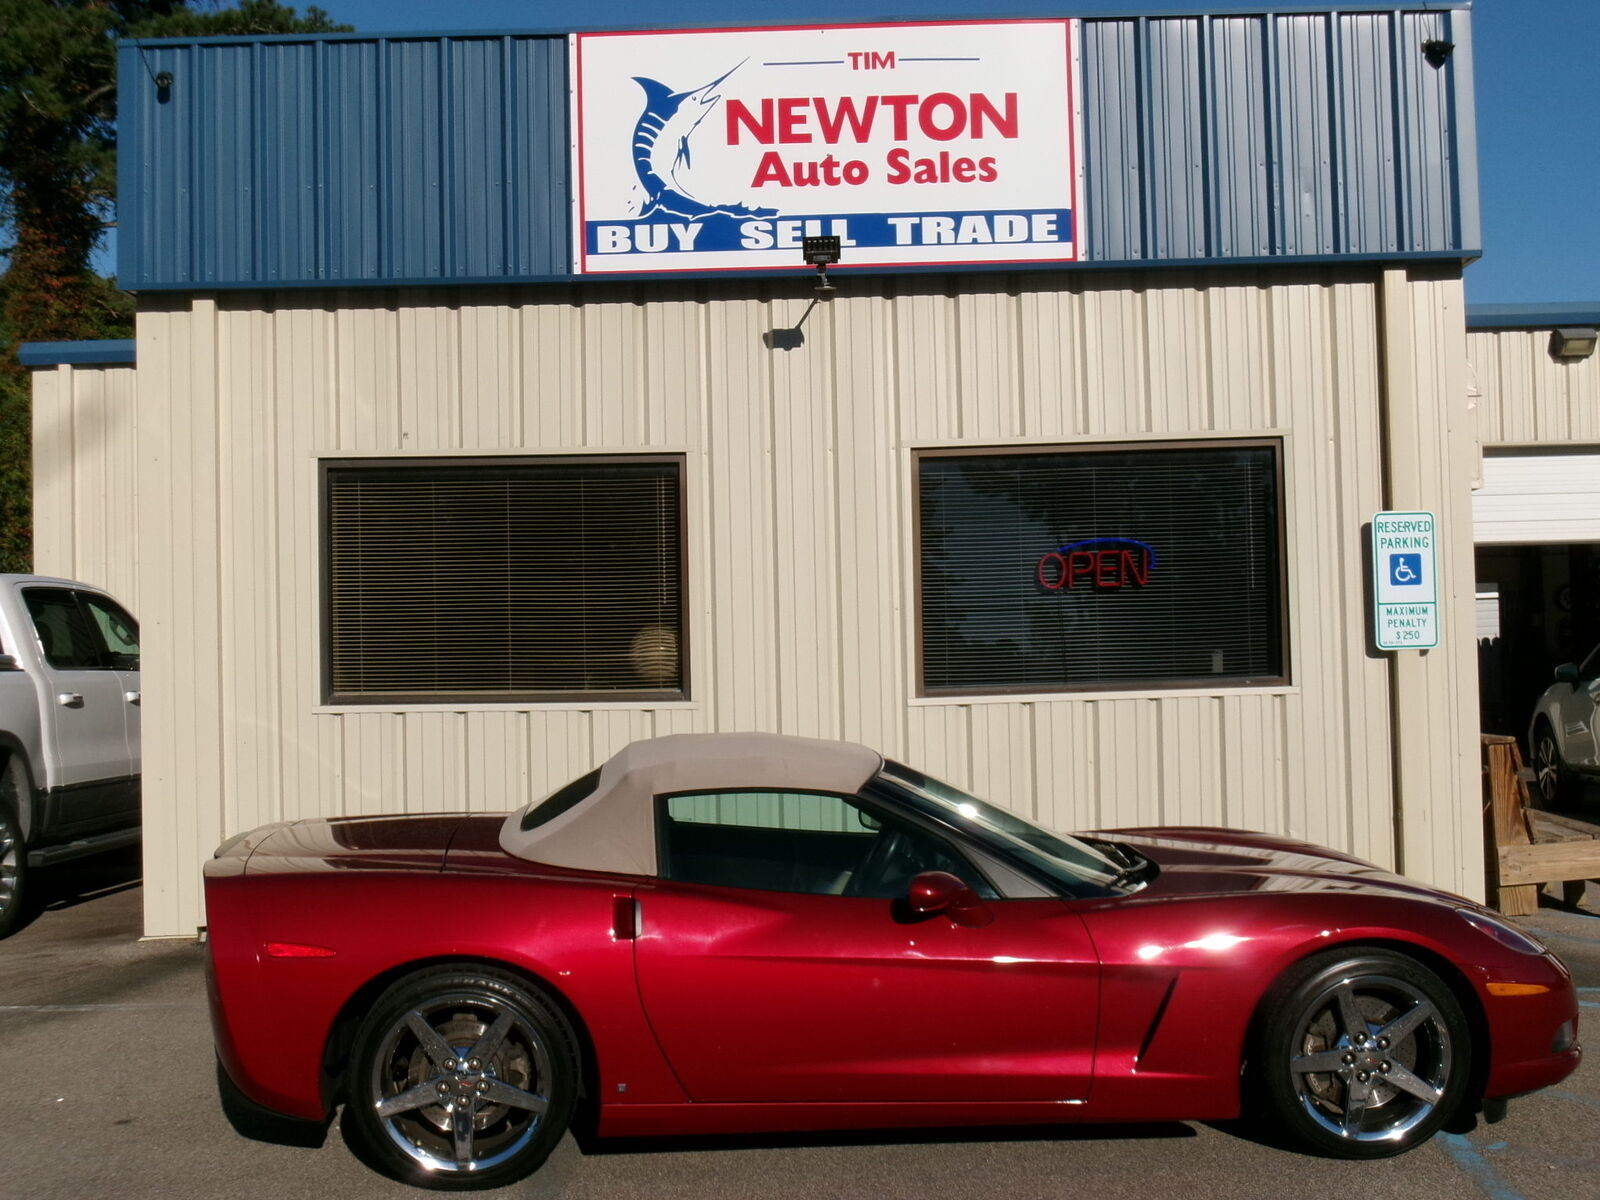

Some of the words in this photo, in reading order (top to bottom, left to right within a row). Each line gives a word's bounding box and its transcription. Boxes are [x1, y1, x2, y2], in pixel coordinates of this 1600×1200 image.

[847, 51, 896, 71] TIM
[725, 91, 1019, 146] NEWTON
[750, 151, 870, 189] Auto
[886, 147, 998, 185] Sales
[597, 222, 703, 254] BUY
[887, 213, 1059, 245] TRADE
[1377, 520, 1431, 533] RESERVED
[1380, 536, 1429, 549] PARKING
[1038, 549, 1148, 590] OPEN
[1386, 606, 1428, 616] MAXIMUM
[1387, 618, 1427, 628] PENALTY
